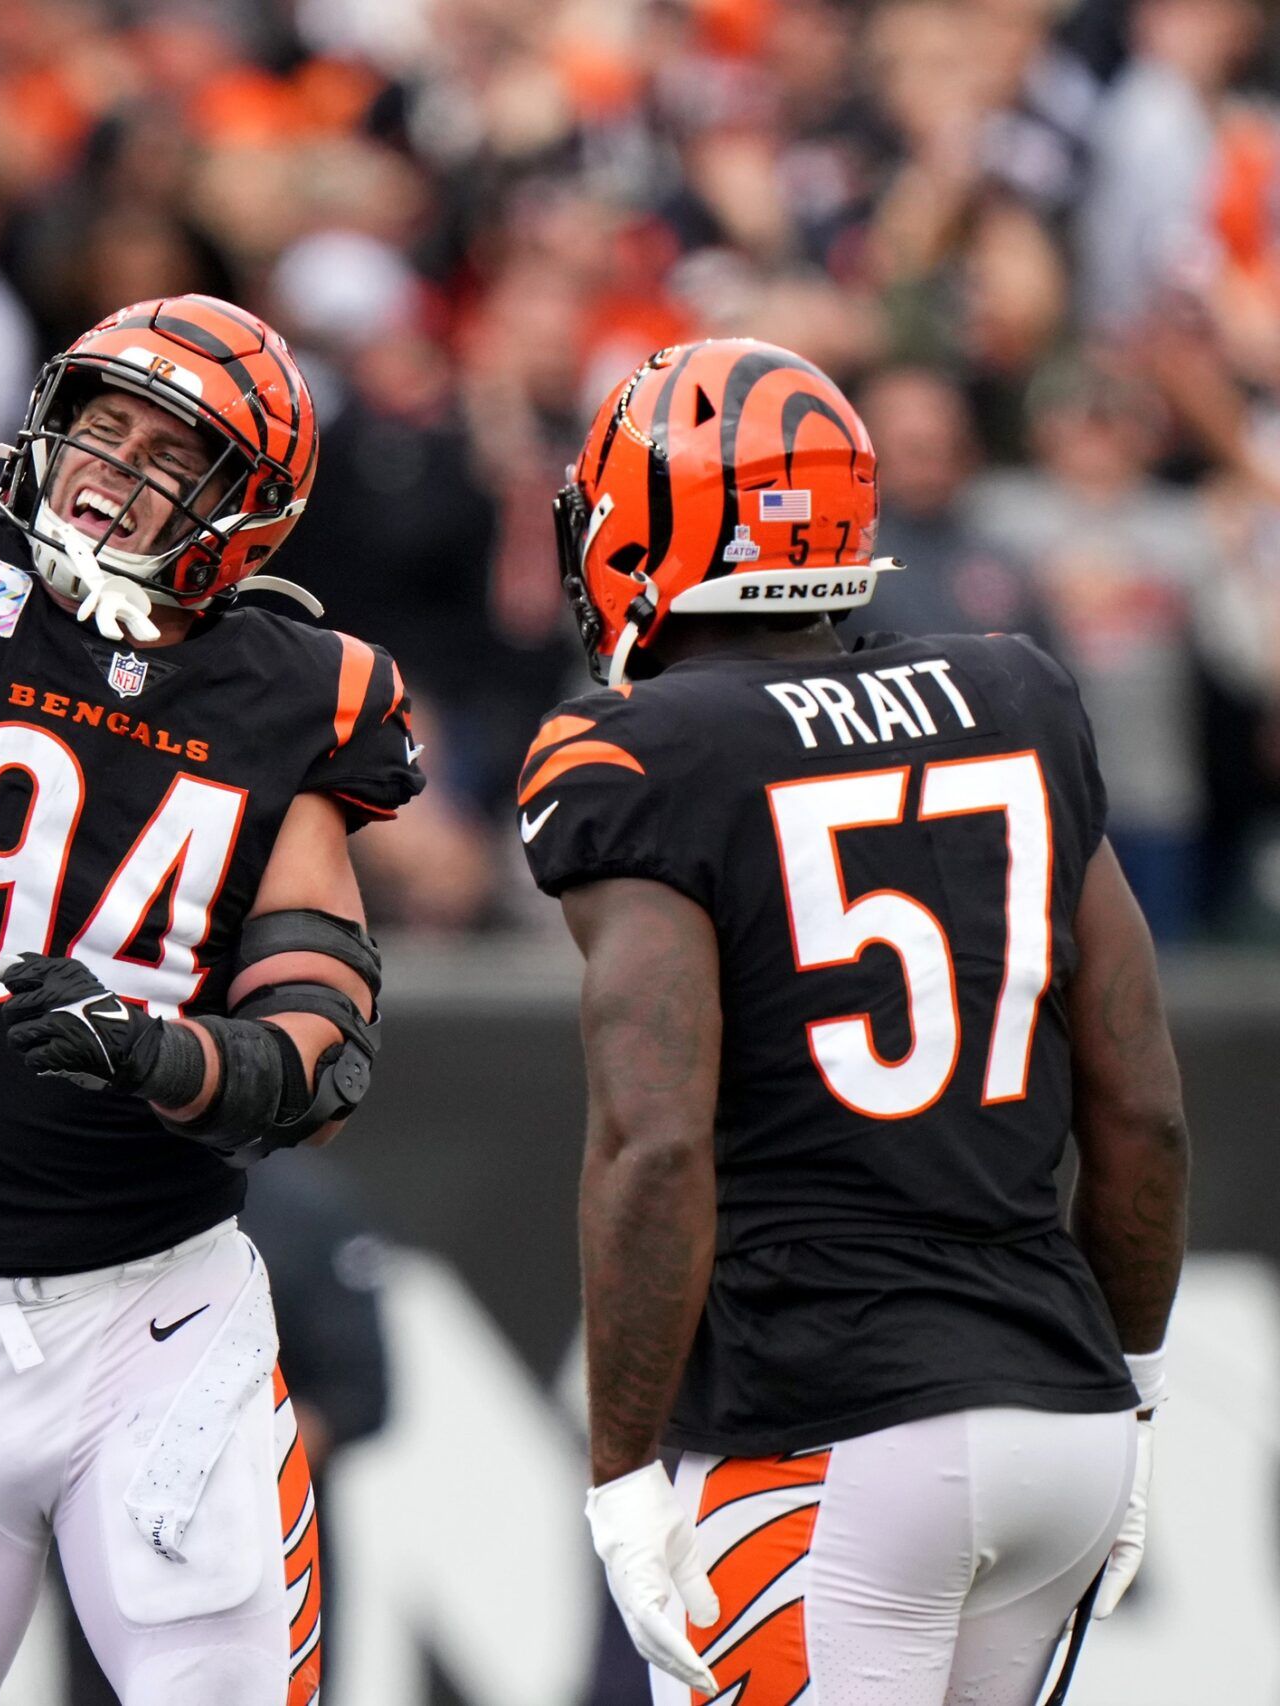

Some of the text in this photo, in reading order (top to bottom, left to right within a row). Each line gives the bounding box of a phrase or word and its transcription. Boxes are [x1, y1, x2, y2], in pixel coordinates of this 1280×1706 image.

[739, 579, 868, 600] BENGALS
[114, 668, 138, 691] NFL
[764, 658, 976, 749] PRATT
[8, 683, 210, 763] BENGALS
[764, 749, 1053, 1121] 57
